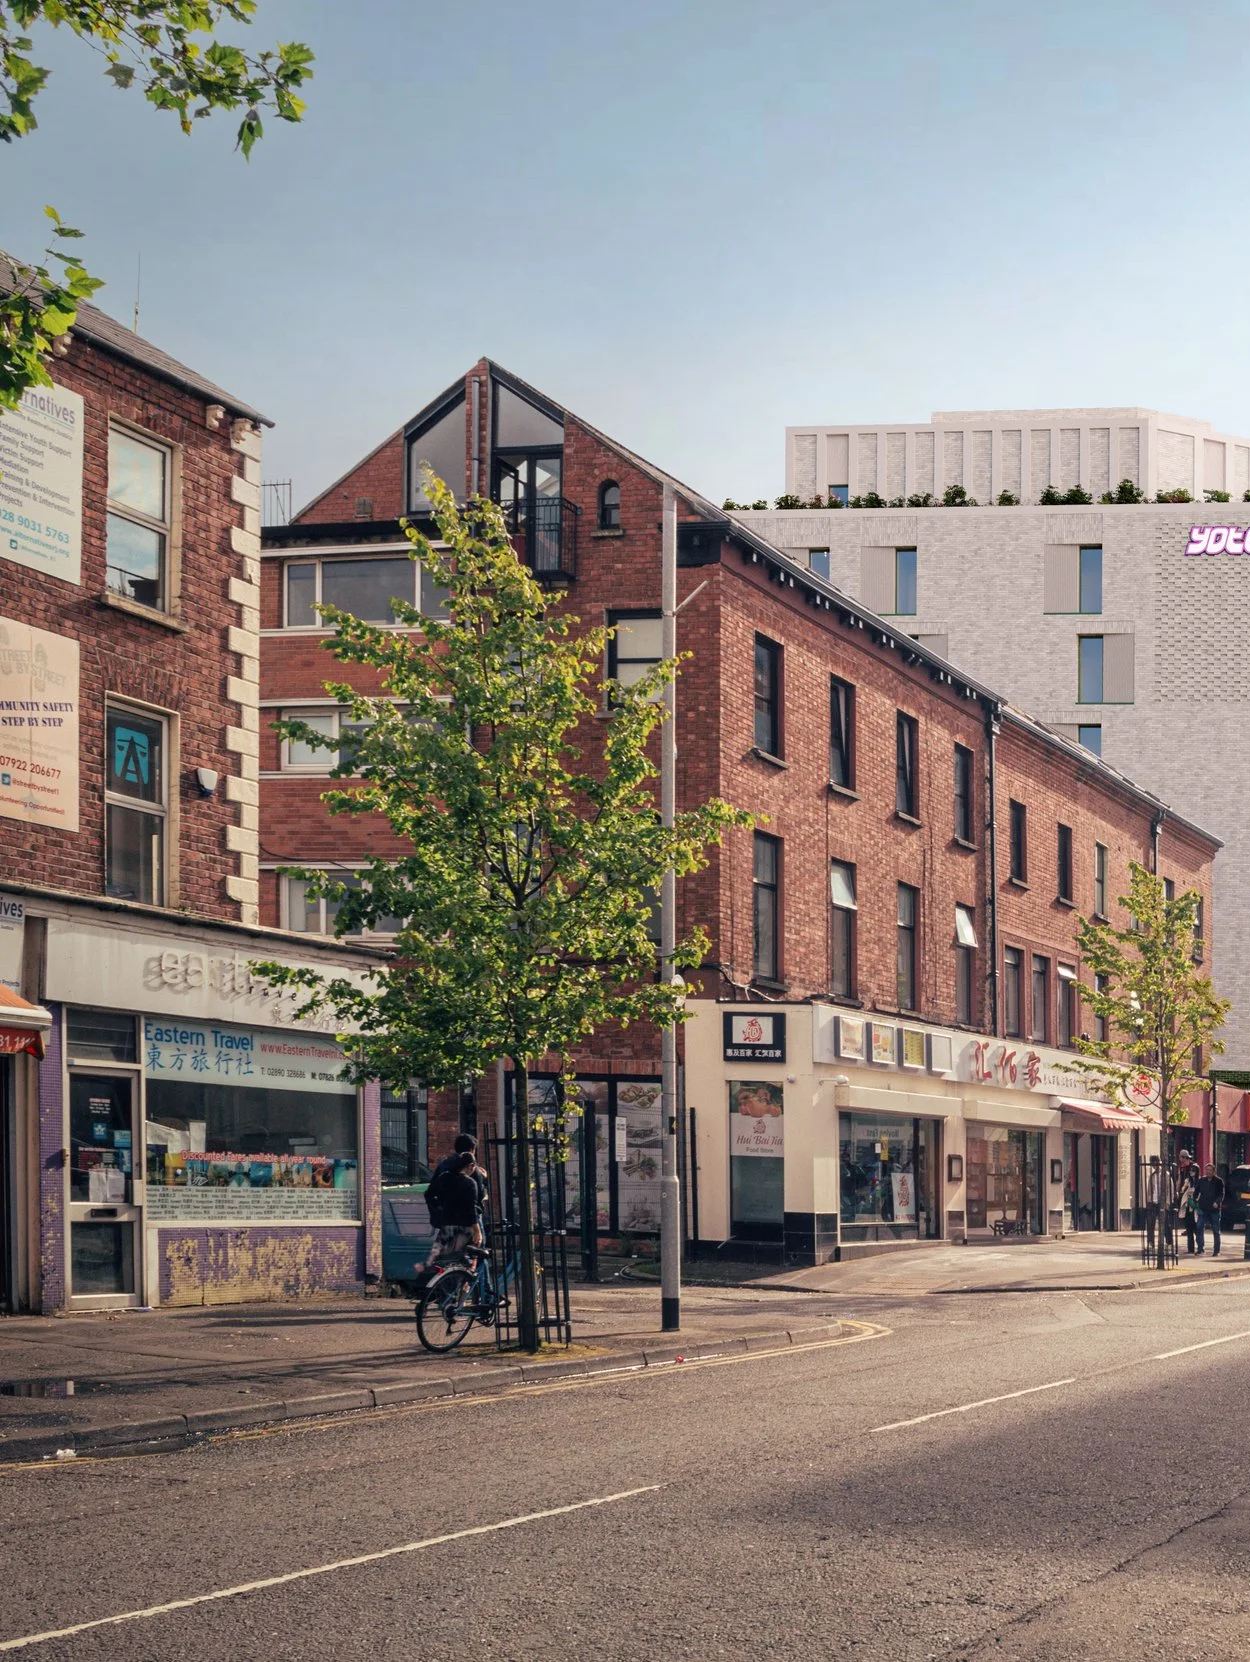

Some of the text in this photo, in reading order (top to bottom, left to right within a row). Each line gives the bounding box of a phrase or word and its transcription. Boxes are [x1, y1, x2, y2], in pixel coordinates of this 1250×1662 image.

[17, 515, 42, 534] 9031
[45, 526, 70, 544] 5763
[43, 702, 74, 712] SAFETY
[2, 716, 63, 727] STEP BY STEP
[0, 755, 61, 779] 07922 206677
[144, 1023, 255, 1052] Eastern Travel
[145, 1043, 255, 1075] 東方旅行社
[181, 1150, 226, 1161] Discounted
[247, 1153, 279, 1163] available
[279, 1154, 289, 1163] all
[289, 1155, 306, 1165] year
[306, 1156, 327, 1165] round
